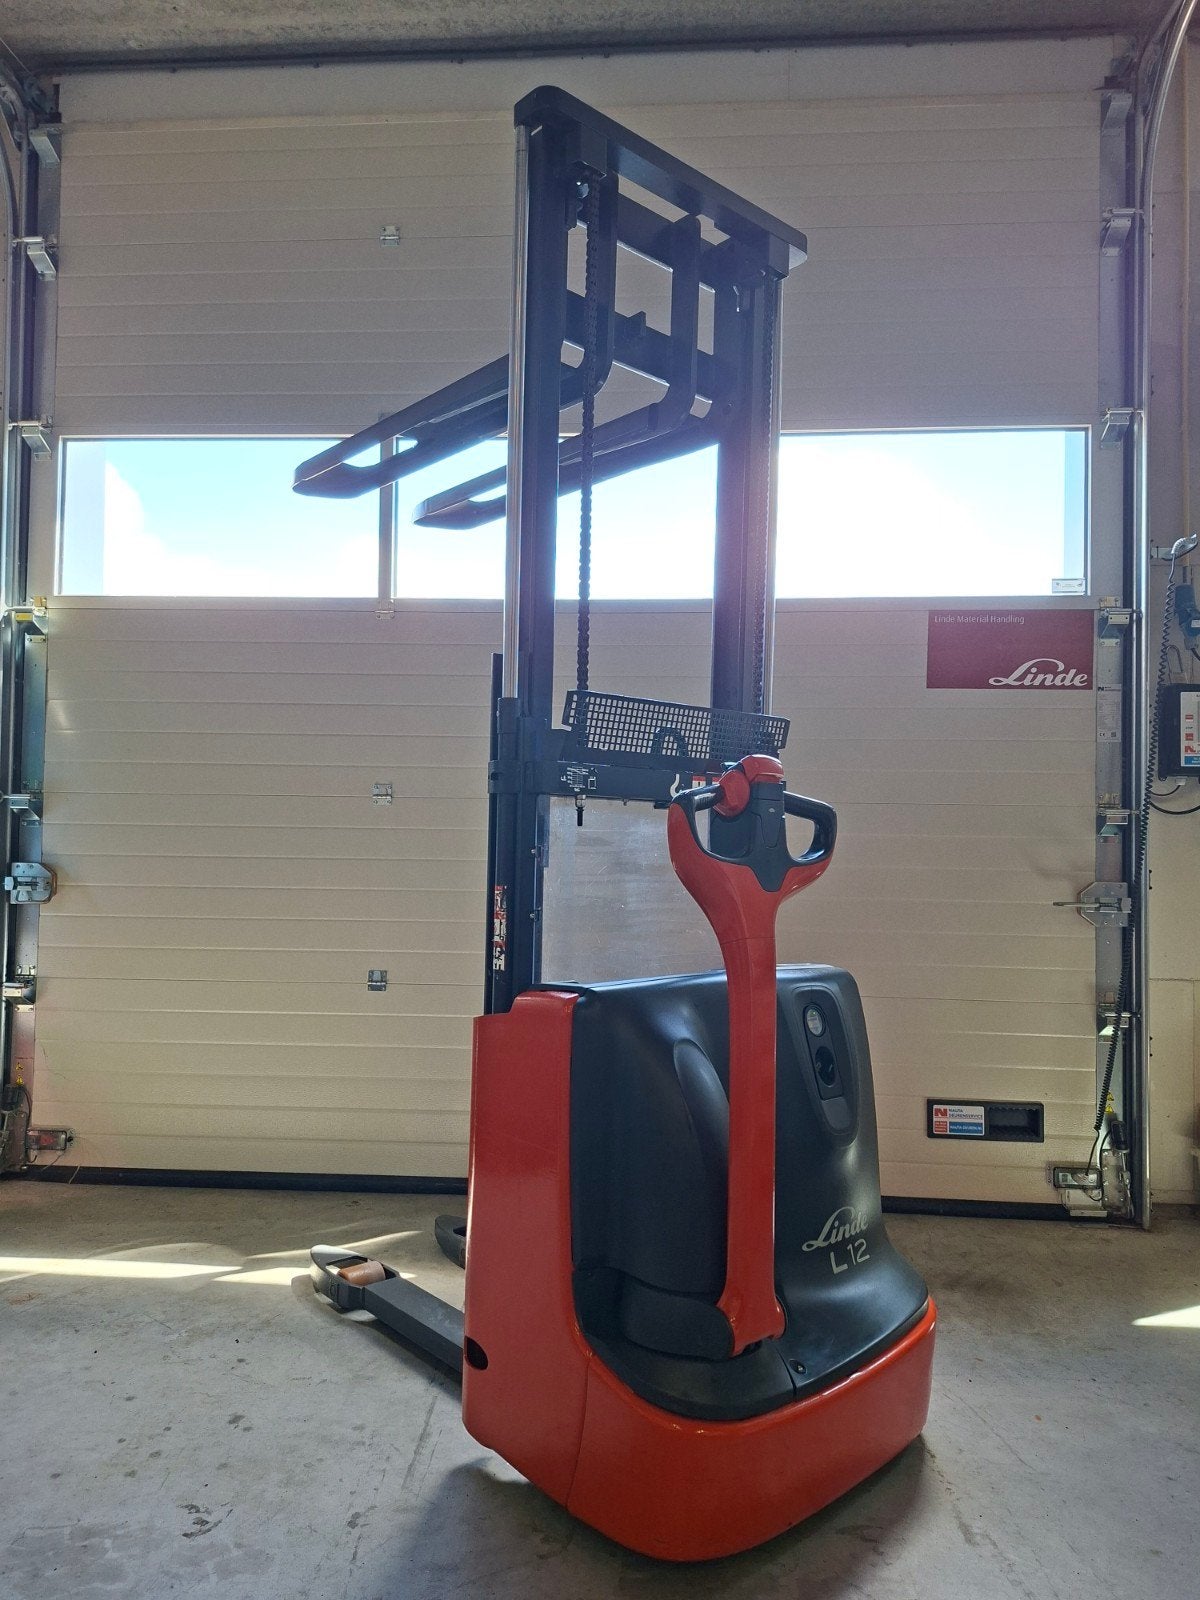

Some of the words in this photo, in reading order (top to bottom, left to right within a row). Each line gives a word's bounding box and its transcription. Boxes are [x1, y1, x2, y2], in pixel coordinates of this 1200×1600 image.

[934, 614, 954, 623] Linde
[957, 614, 989, 623] Material
[990, 614, 1025, 625] Handling
[988, 658, 1088, 686] Linde
[801, 1206, 869, 1252] Linde
